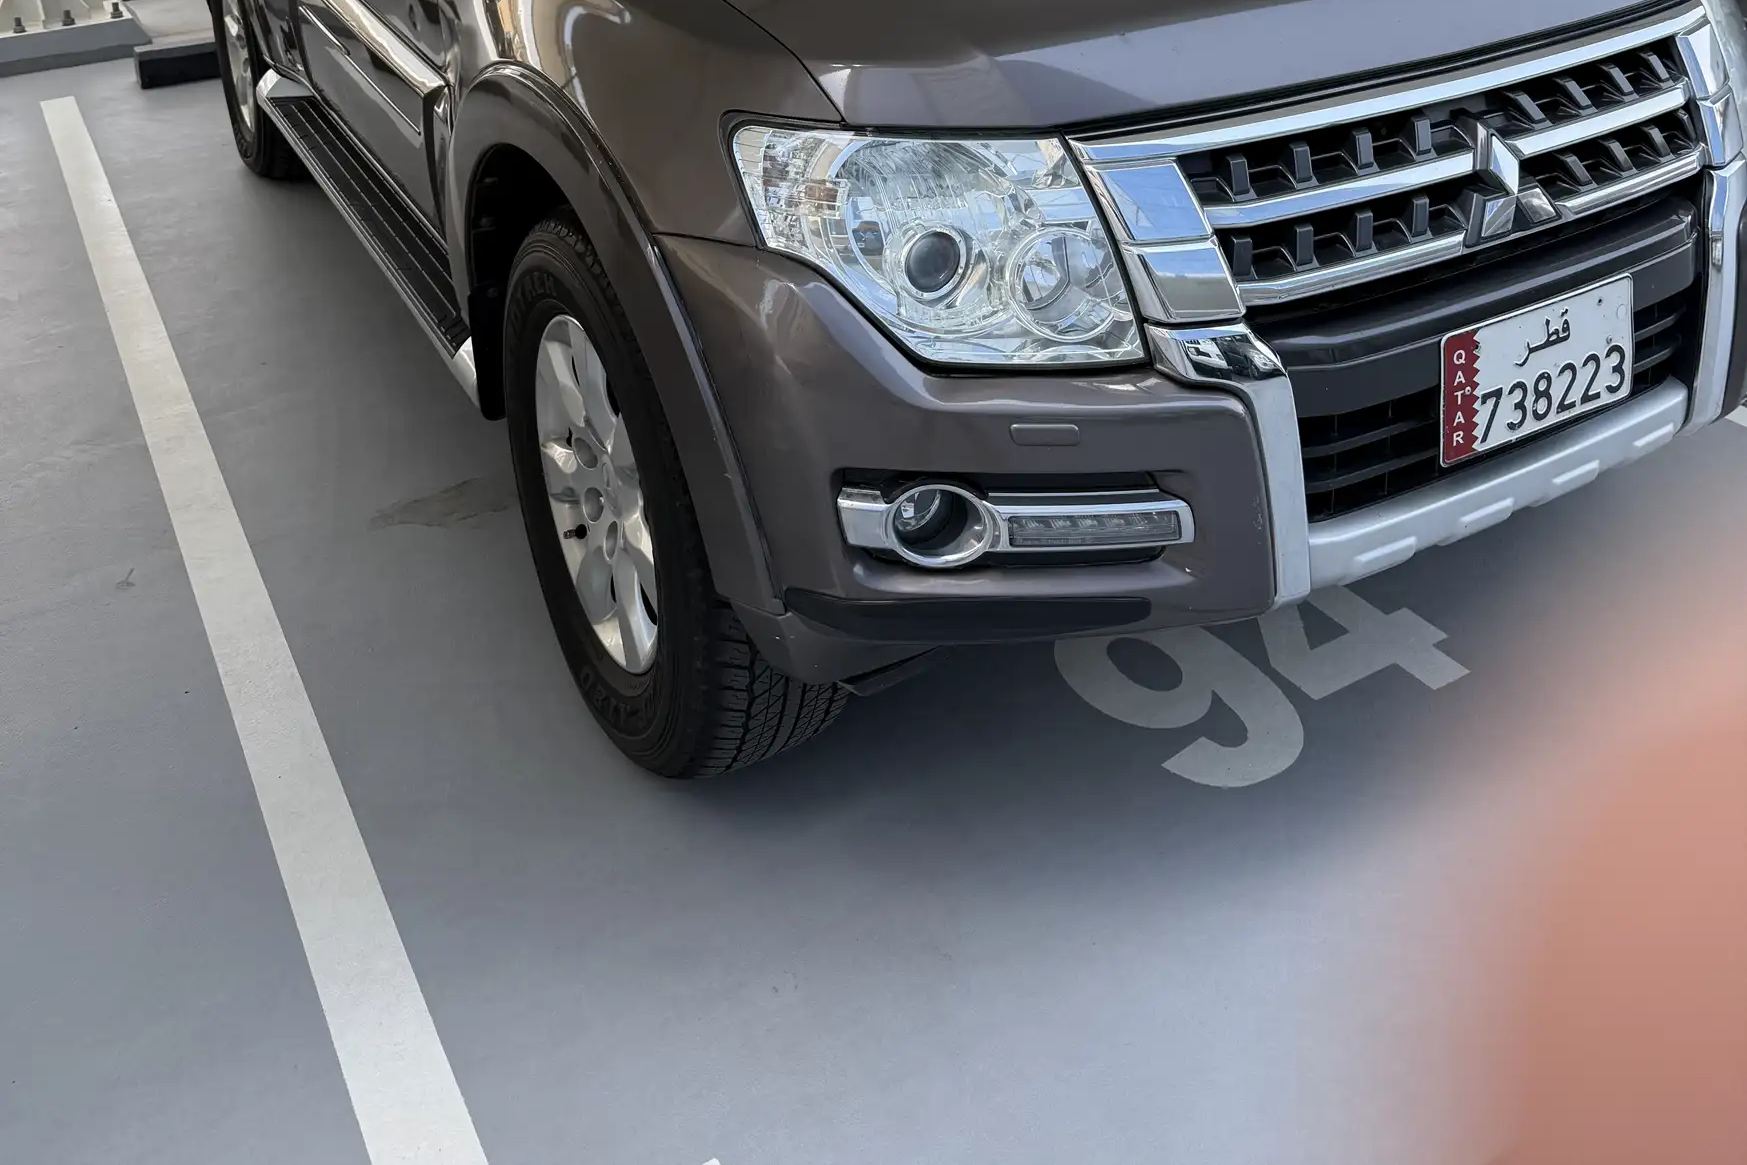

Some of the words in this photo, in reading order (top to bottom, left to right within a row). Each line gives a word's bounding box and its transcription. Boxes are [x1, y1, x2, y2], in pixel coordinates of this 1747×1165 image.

[1514, 307, 1571, 367] قطر
[1453, 349, 1466, 446] QATAR
[1480, 343, 1626, 444] 738223
[1053, 585, 1471, 787] 94
